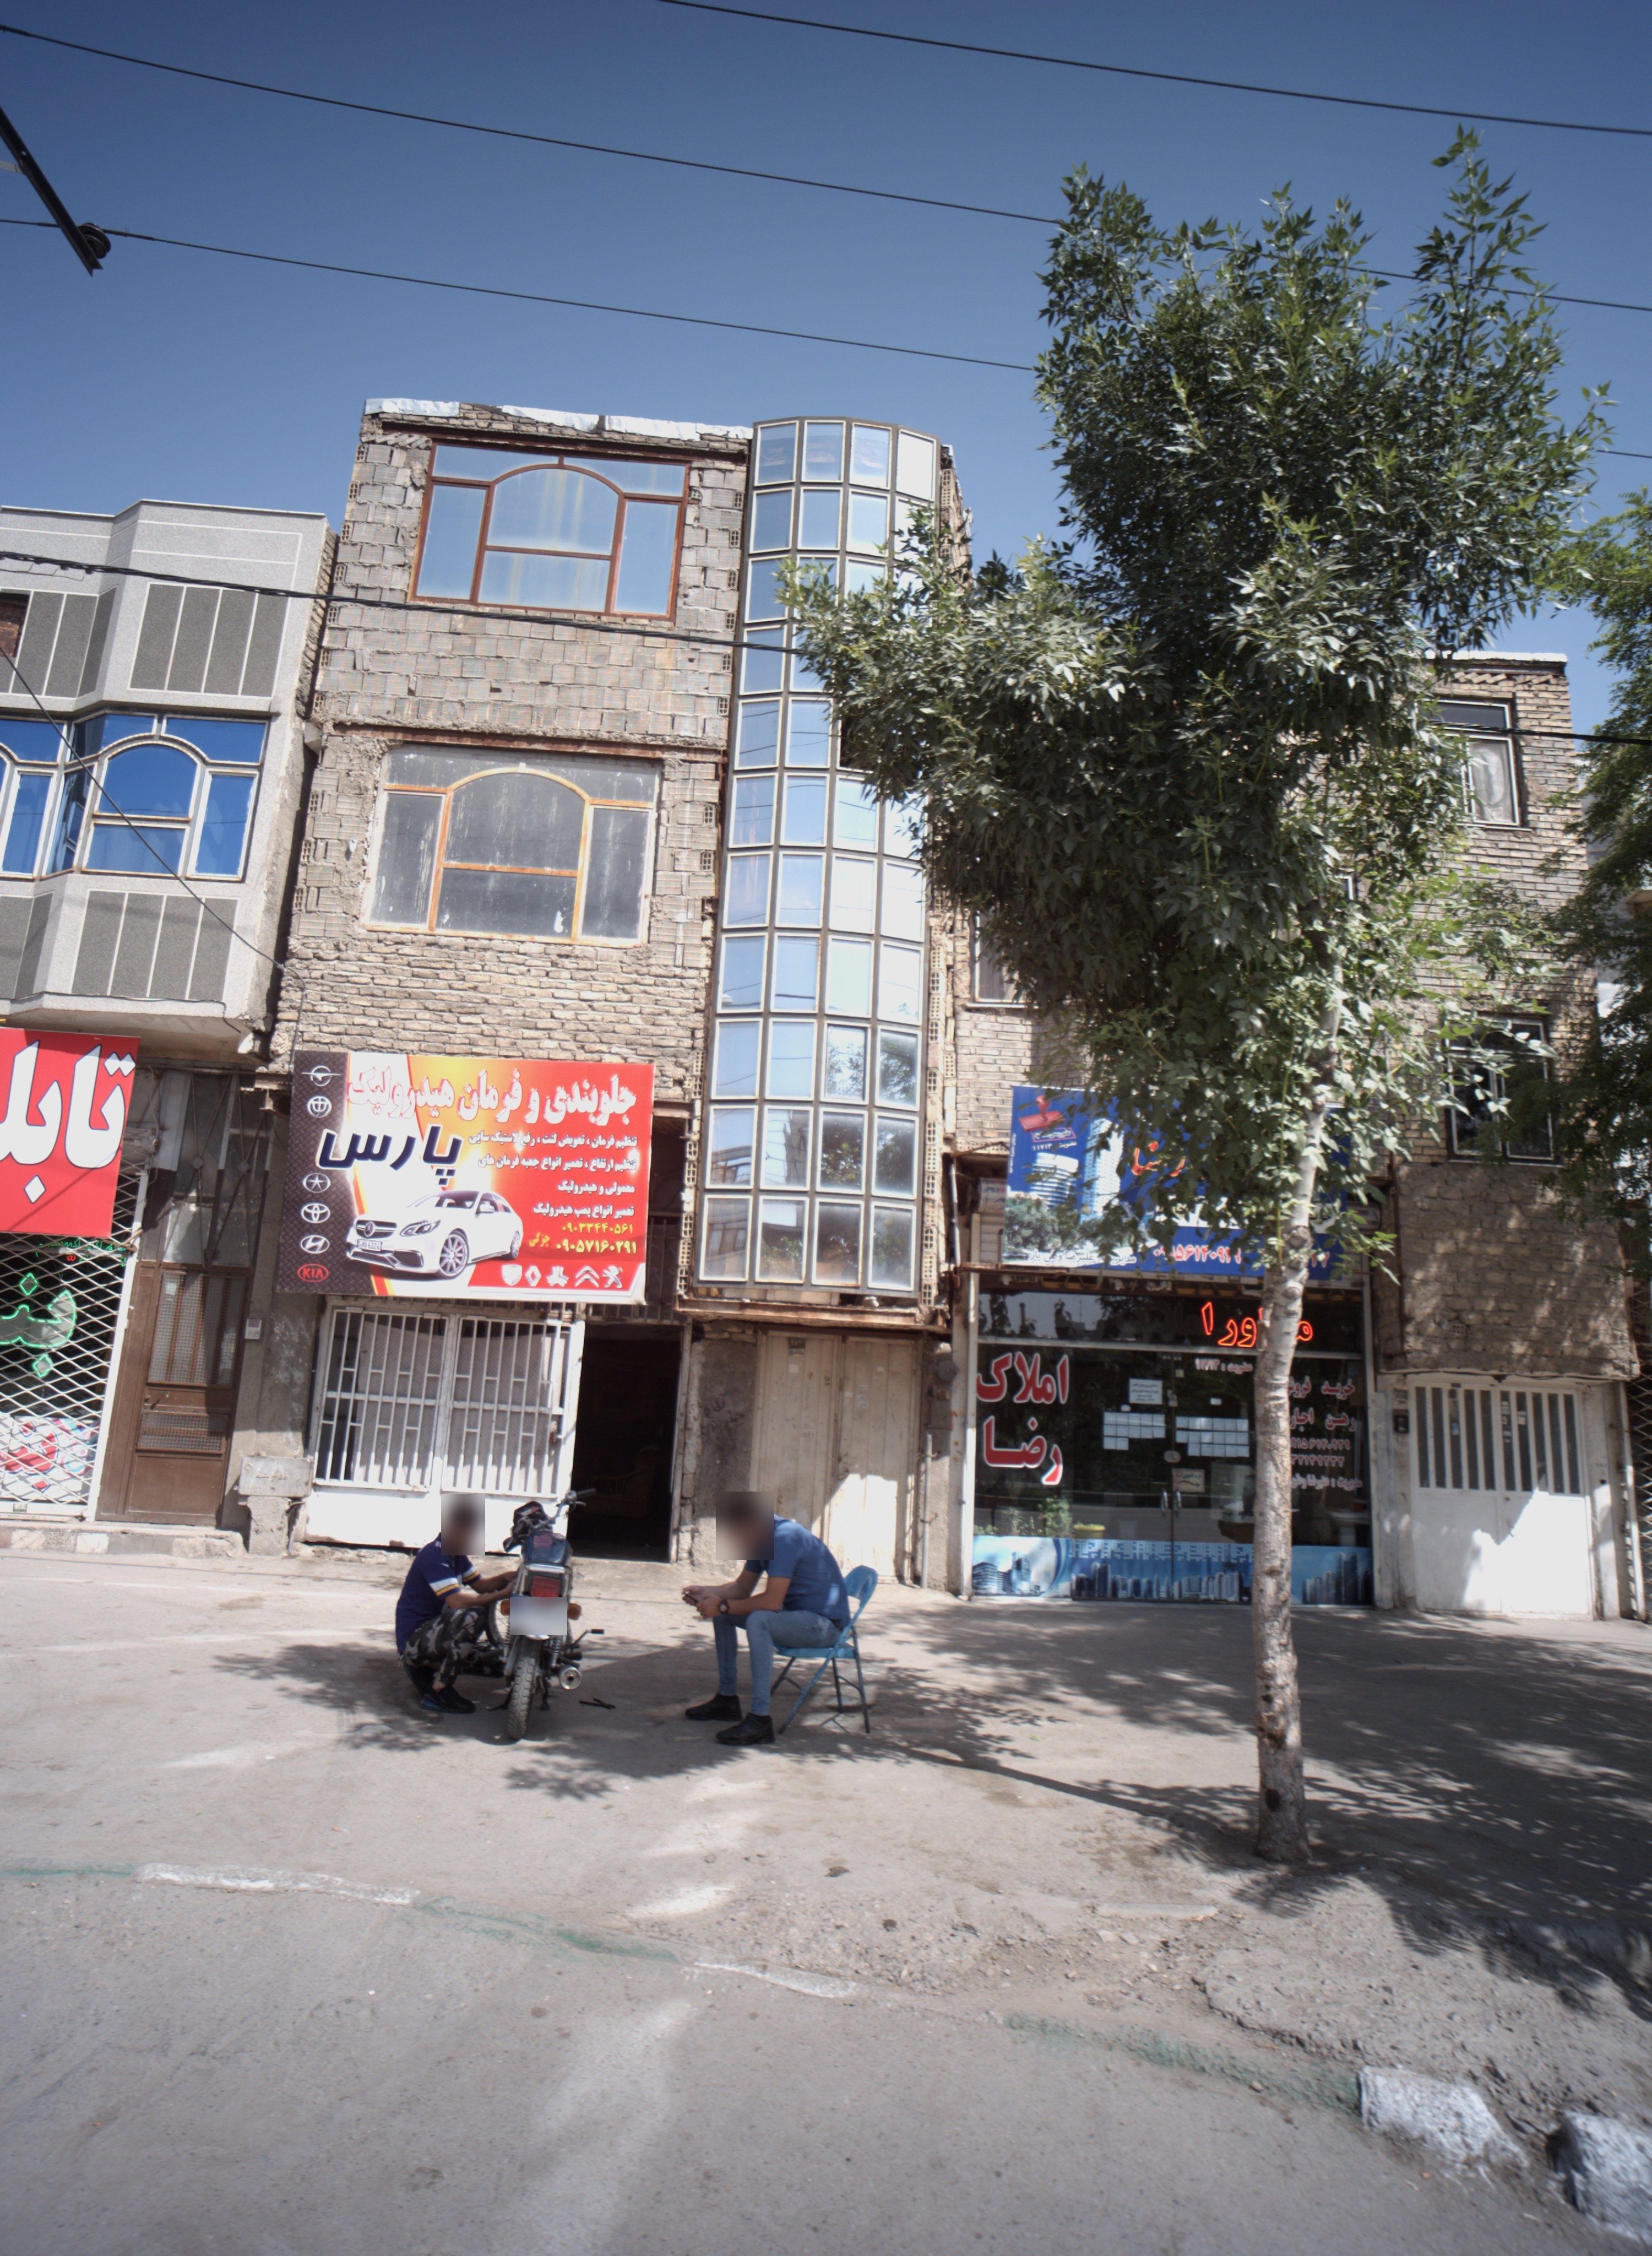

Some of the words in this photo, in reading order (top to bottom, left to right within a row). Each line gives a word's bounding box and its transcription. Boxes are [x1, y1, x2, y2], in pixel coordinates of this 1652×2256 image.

[347, 1066, 455, 1119] هیدرولیک
[458, 1069, 523, 1123] فرمان
[544, 1074, 637, 1126] جلوبندی
[525, 1088, 540, 1124] و
[0, 1039, 136, 1203] تابل
[491, 1131, 519, 1145] لاستیک
[558, 1135, 585, 1148] تعویض
[616, 1135, 638, 1149] تنظیم
[318, 1125, 463, 1186] پارس
[478, 1153, 495, 1168] های
[496, 1154, 520, 1169] فرمان
[521, 1157, 540, 1169] جعبه
[541, 1157, 562, 1170] انواع
[563, 1158, 583, 1171] تعمیر
[615, 1159, 637, 1172] تنظیم
[557, 1180, 597, 1195] هیدرولیک
[599, 1185, 604, 1195] و
[605, 1181, 635, 1196] معمولی
[534, 1202, 573, 1217] هیدرولیک
[574, 1206, 591, 1218] پمپ
[592, 1204, 613, 1218] انواع
[614, 1206, 634, 1219] تعمیر
[303, 1268, 324, 1278] KIA
[976, 1351, 1070, 1404] املاک
[1321, 1378, 1355, 1400] خرید
[1290, 1407, 1314, 1432] اجار
[1325, 1412, 1356, 1432] رهن
[983, 1415, 1063, 1485] رضا
